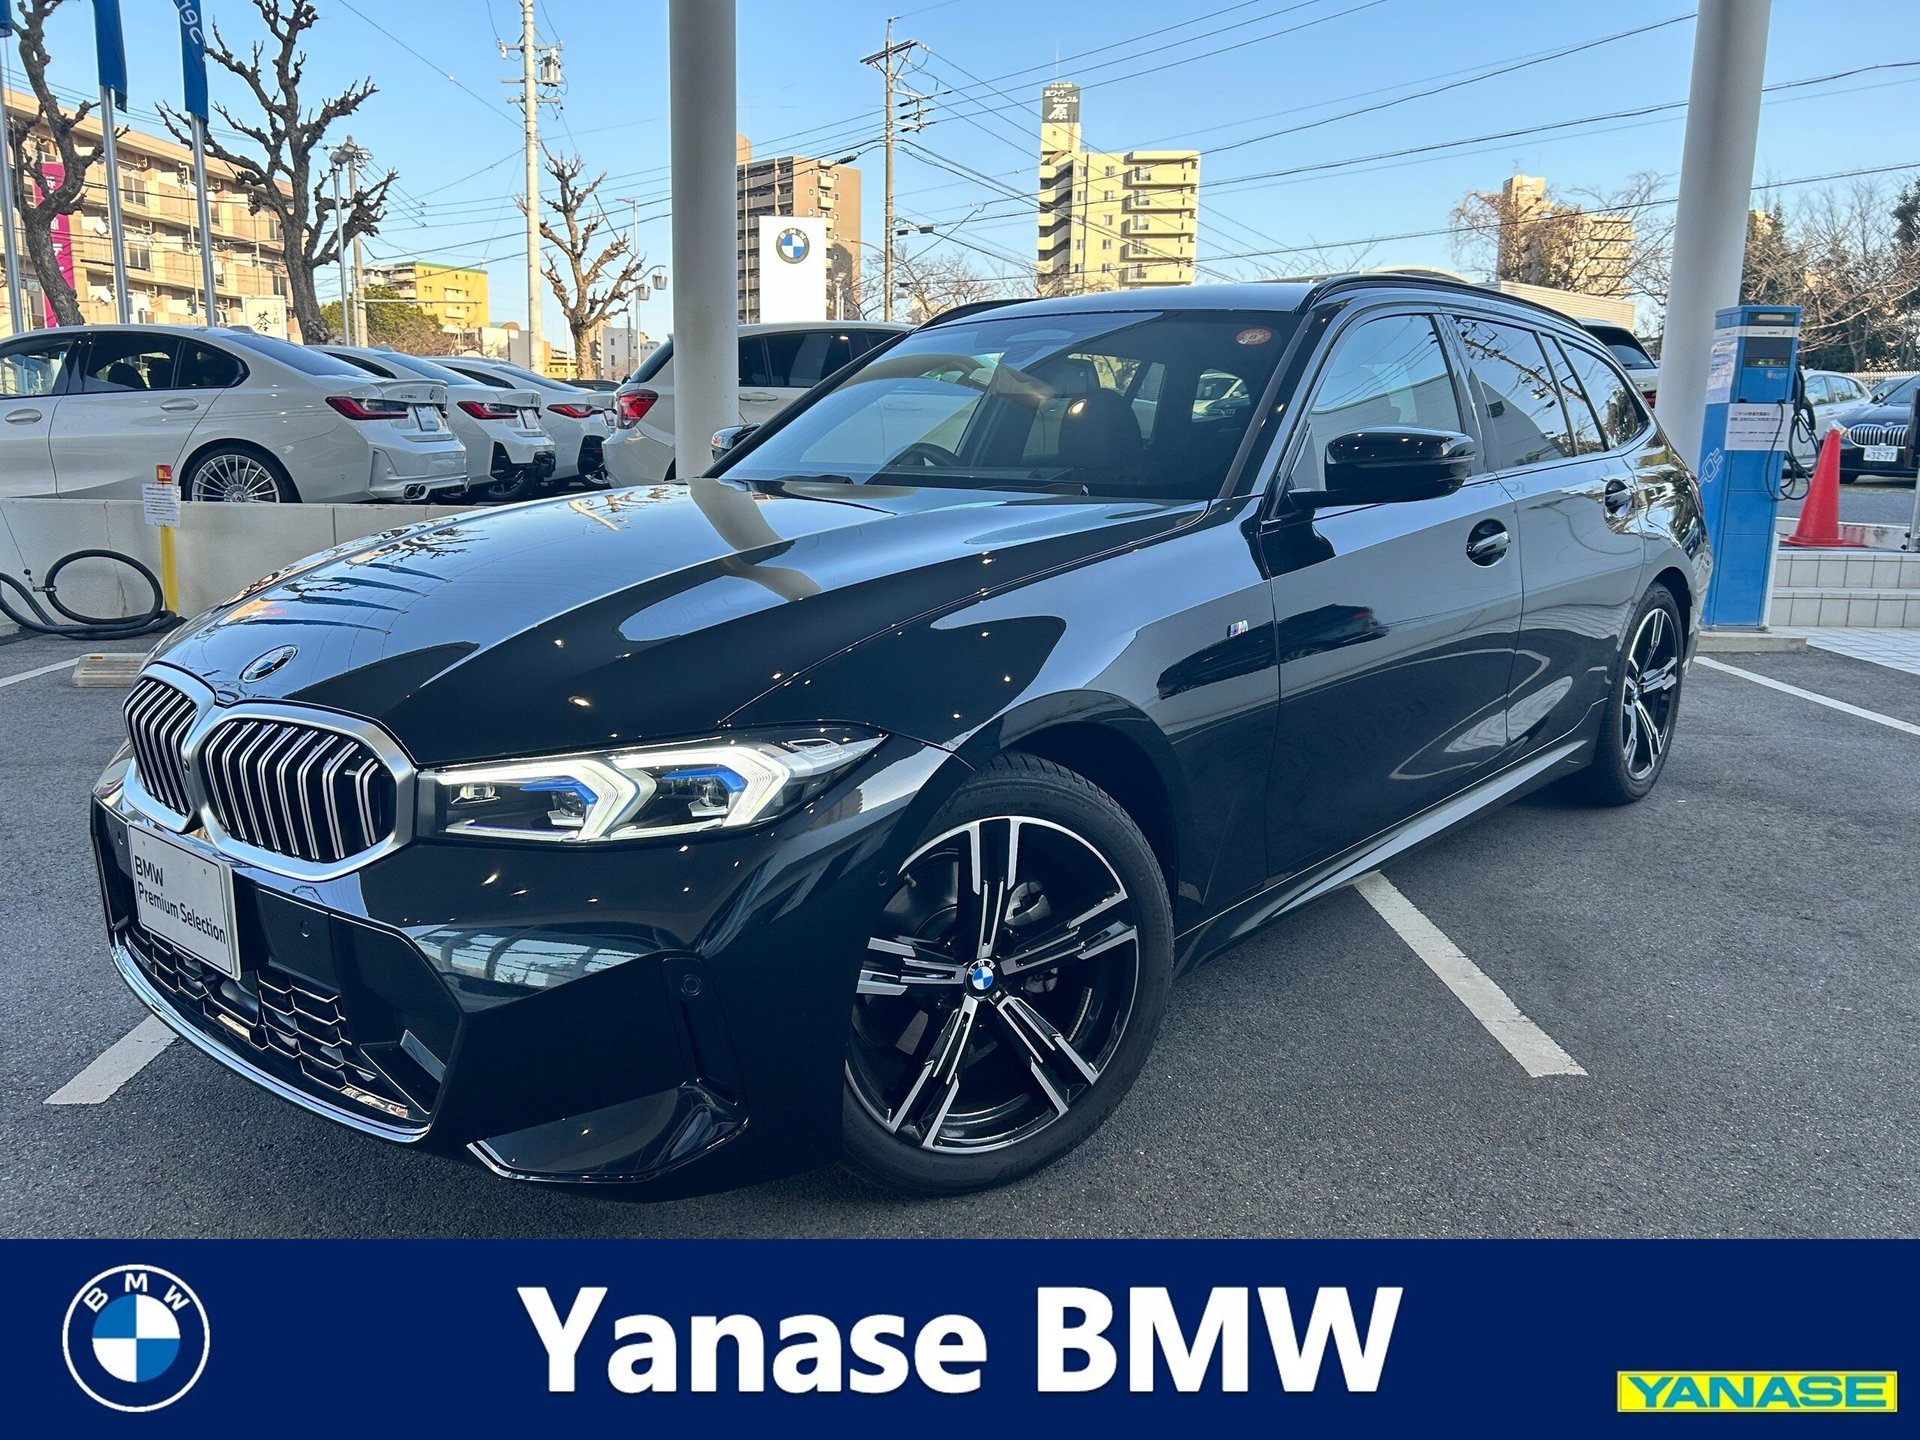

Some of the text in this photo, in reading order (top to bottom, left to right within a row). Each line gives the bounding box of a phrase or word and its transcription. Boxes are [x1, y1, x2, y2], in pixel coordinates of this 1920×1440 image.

[780, 228, 806, 240] BMW
[135, 855, 164, 887] BMW
[138, 881, 226, 944] Premium Selection
